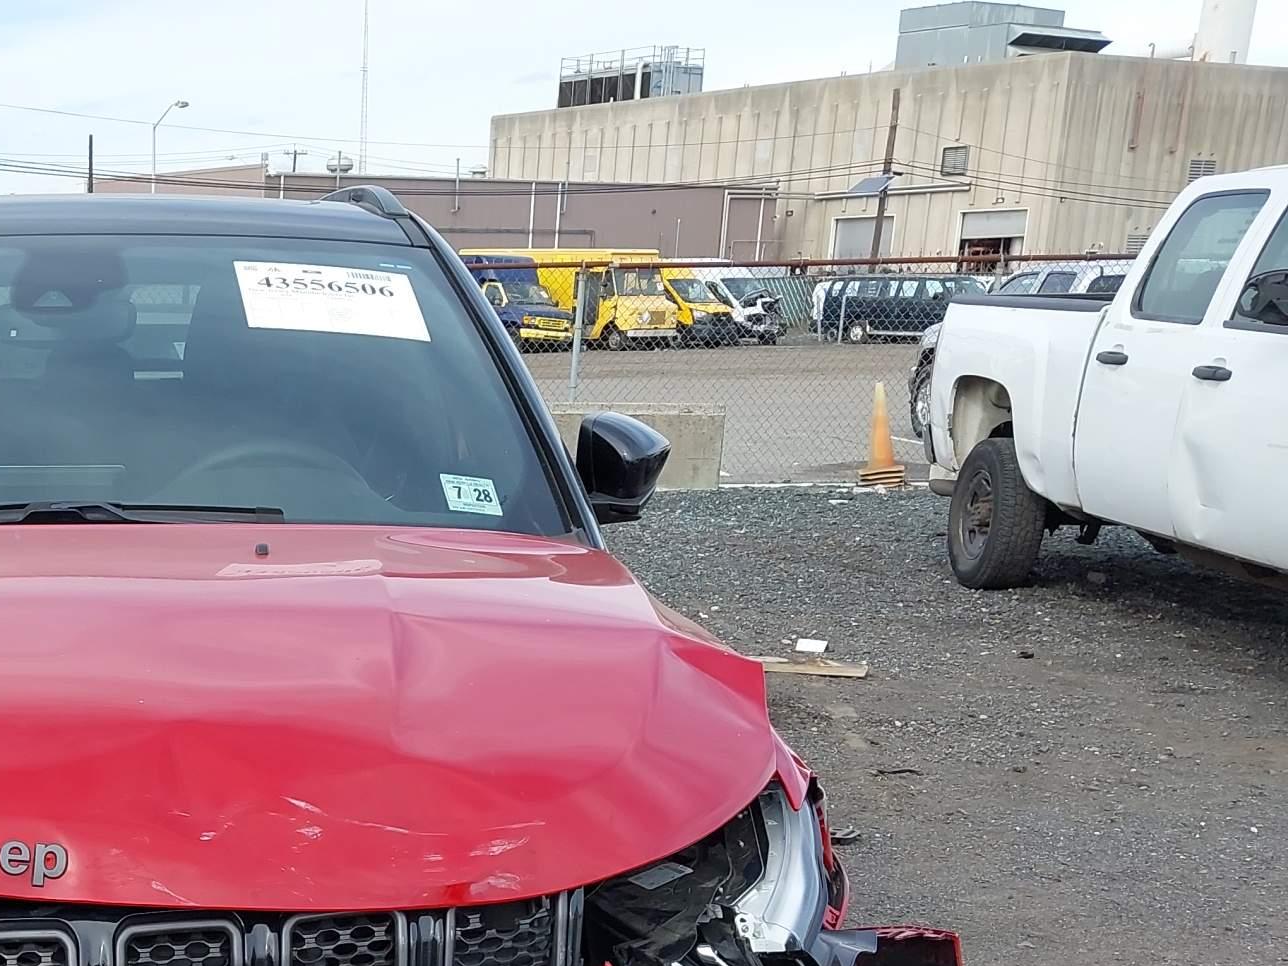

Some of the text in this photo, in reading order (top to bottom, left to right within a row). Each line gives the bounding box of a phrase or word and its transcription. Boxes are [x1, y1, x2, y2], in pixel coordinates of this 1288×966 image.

[257, 276, 395, 297] 43556506
[452, 485, 493, 503] 7 28
